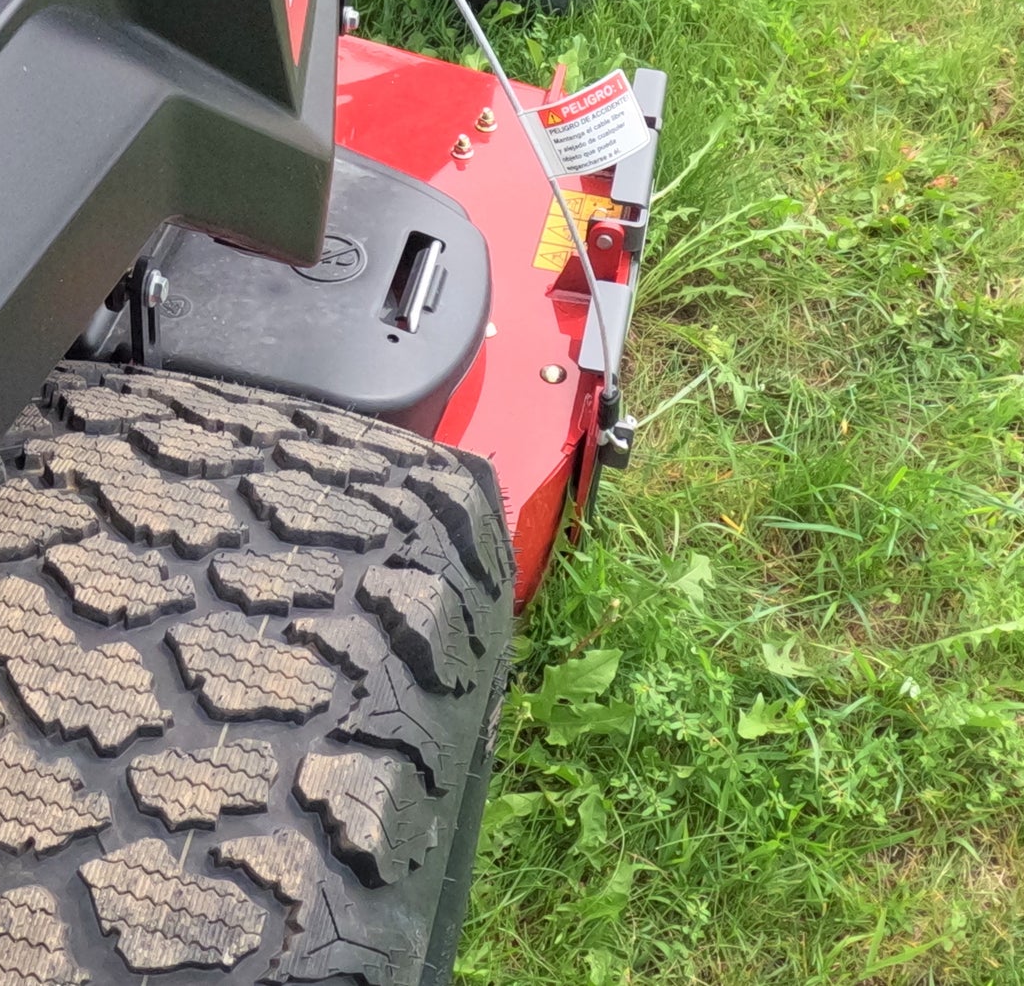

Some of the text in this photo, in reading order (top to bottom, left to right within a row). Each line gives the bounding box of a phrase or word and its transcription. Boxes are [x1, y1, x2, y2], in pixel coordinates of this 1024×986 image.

[560, 84, 617, 118] PELIGRO:
[549, 121, 580, 135] PELIGRO
[580, 116, 591, 125] DE
[553, 131, 585, 144] Mantenga
[593, 118, 611, 130] cable
[583, 149, 596, 157] que
[597, 139, 617, 152] pueda
[587, 137, 596, 145] de
